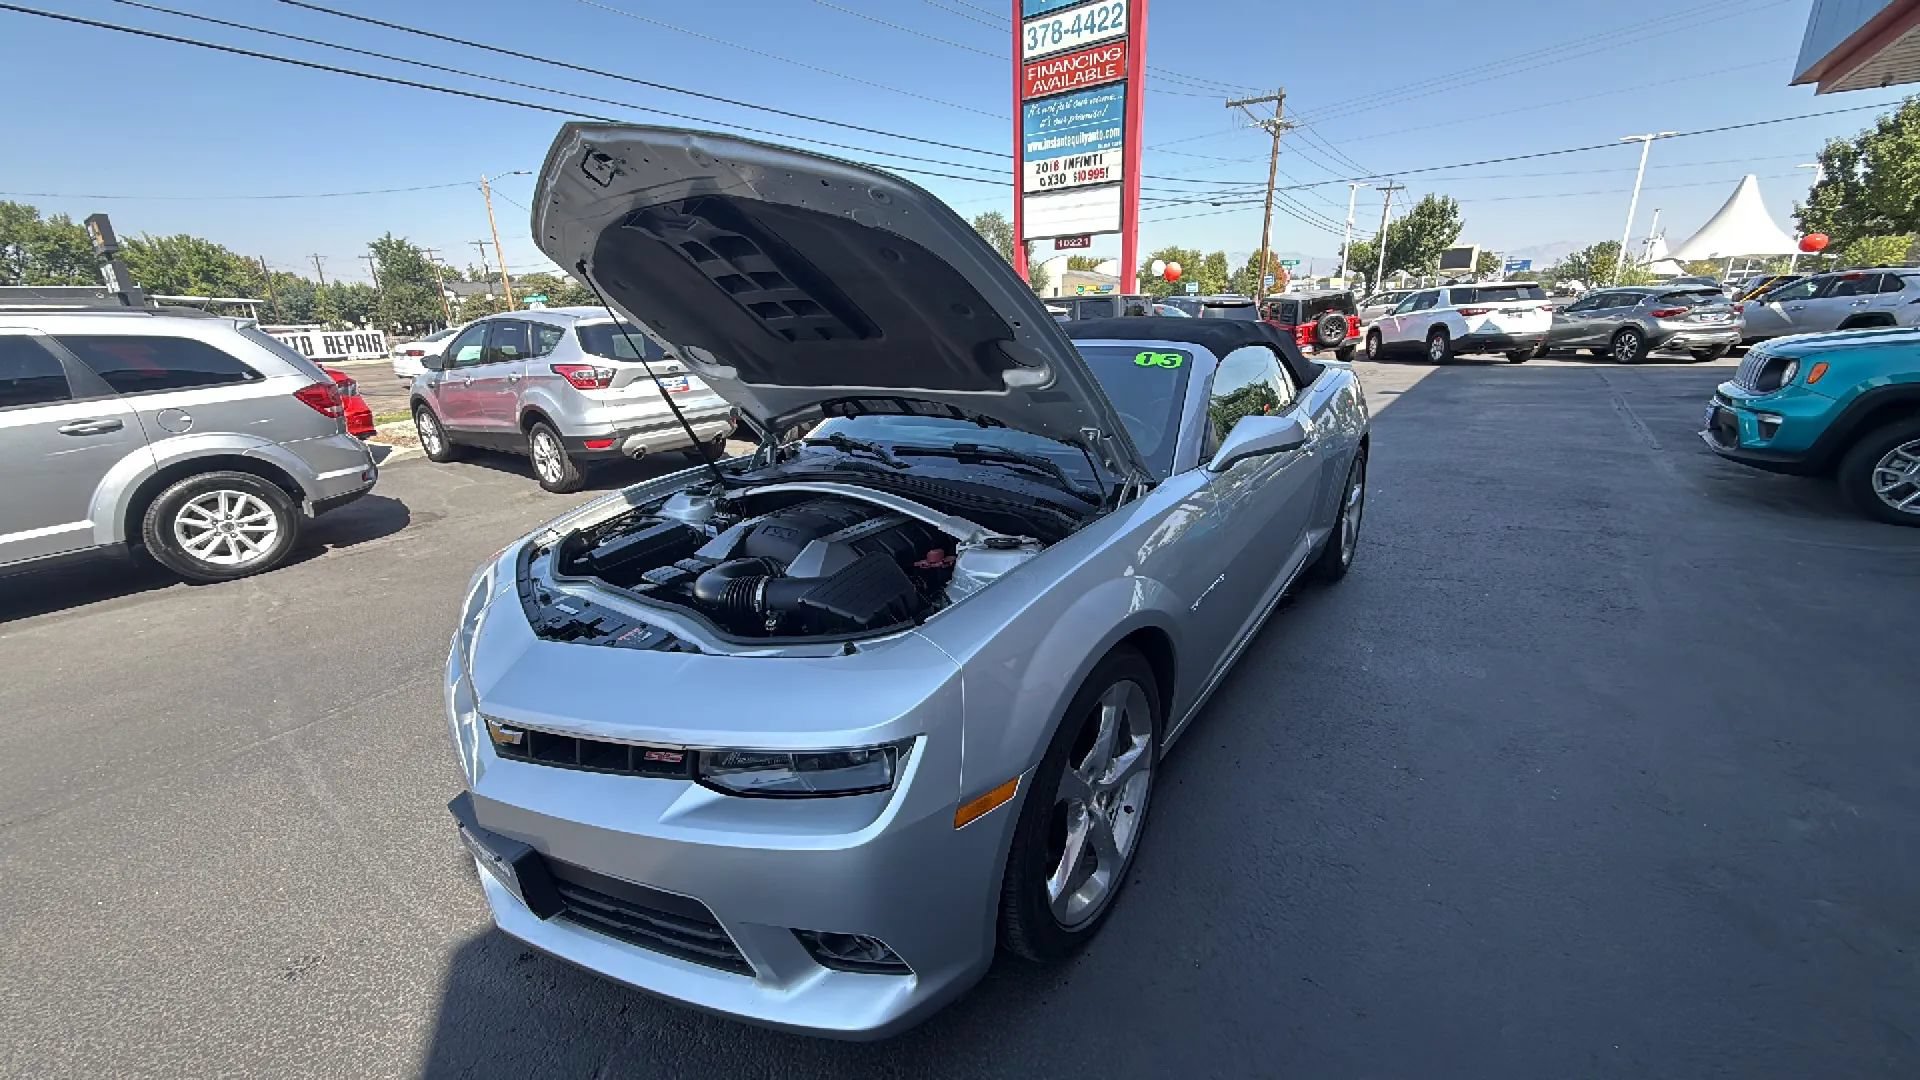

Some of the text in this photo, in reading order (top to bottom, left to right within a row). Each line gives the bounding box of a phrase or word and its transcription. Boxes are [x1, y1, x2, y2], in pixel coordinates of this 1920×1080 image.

[1027, 2, 1124, 50] 378-4422
[1027, 47, 1122, 80] FINANCING
[1031, 63, 1116, 94] AVAILABLE
[1035, 160, 1060, 175] 2018
[1057, 237, 1089, 248] 10221
[322, 333, 384, 354] REPAIR
